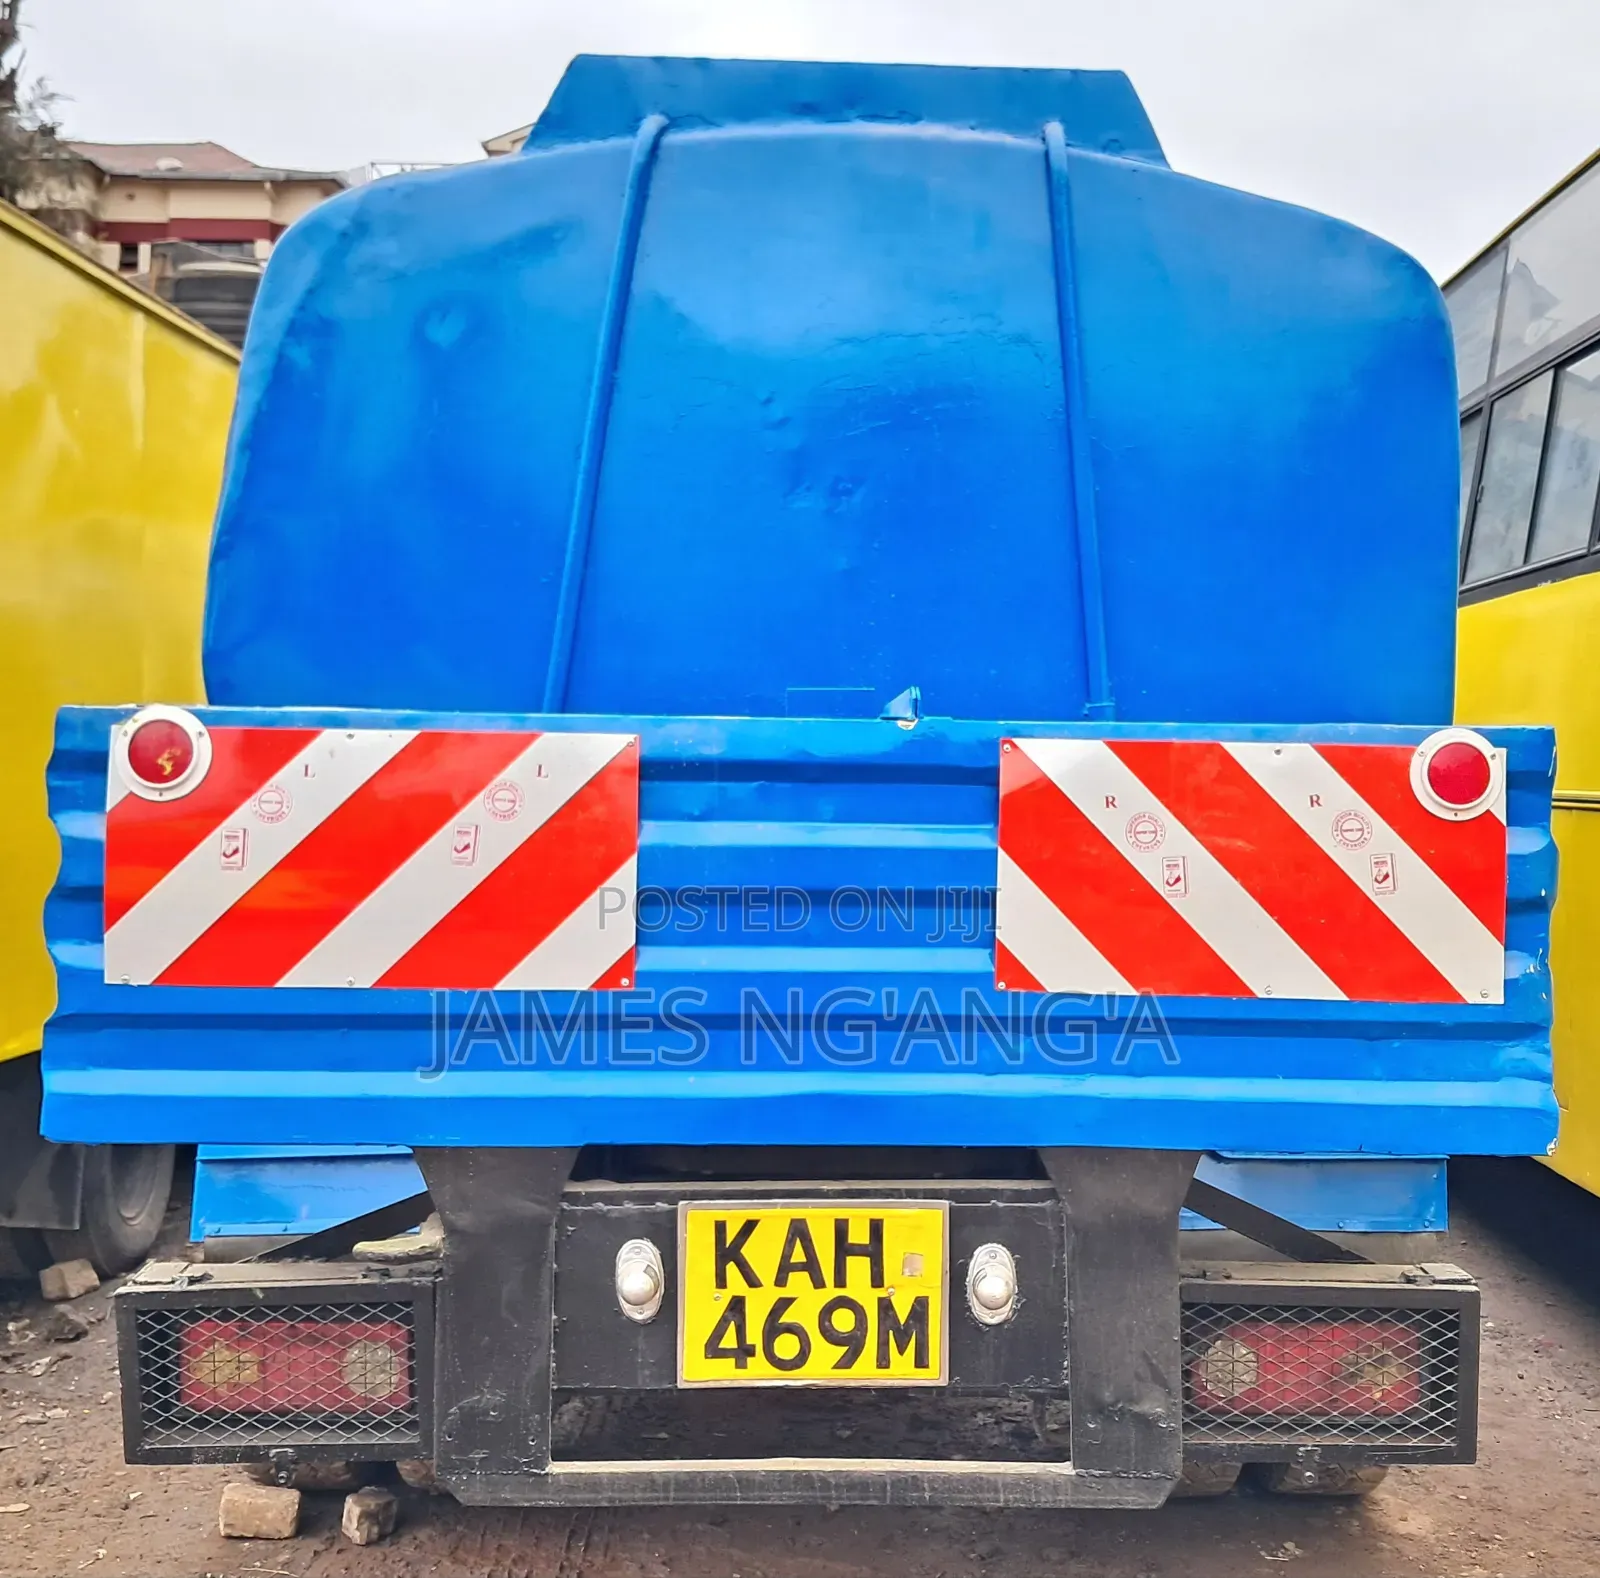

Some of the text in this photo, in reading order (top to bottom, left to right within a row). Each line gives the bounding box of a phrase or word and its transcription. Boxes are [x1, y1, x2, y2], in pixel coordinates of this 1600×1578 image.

[537, 764, 549, 778] L
[1105, 795, 1118, 808] R
[1309, 794, 1322, 808] R
[714, 1218, 885, 1289] KAH
[704, 1295, 930, 1371] 469M
